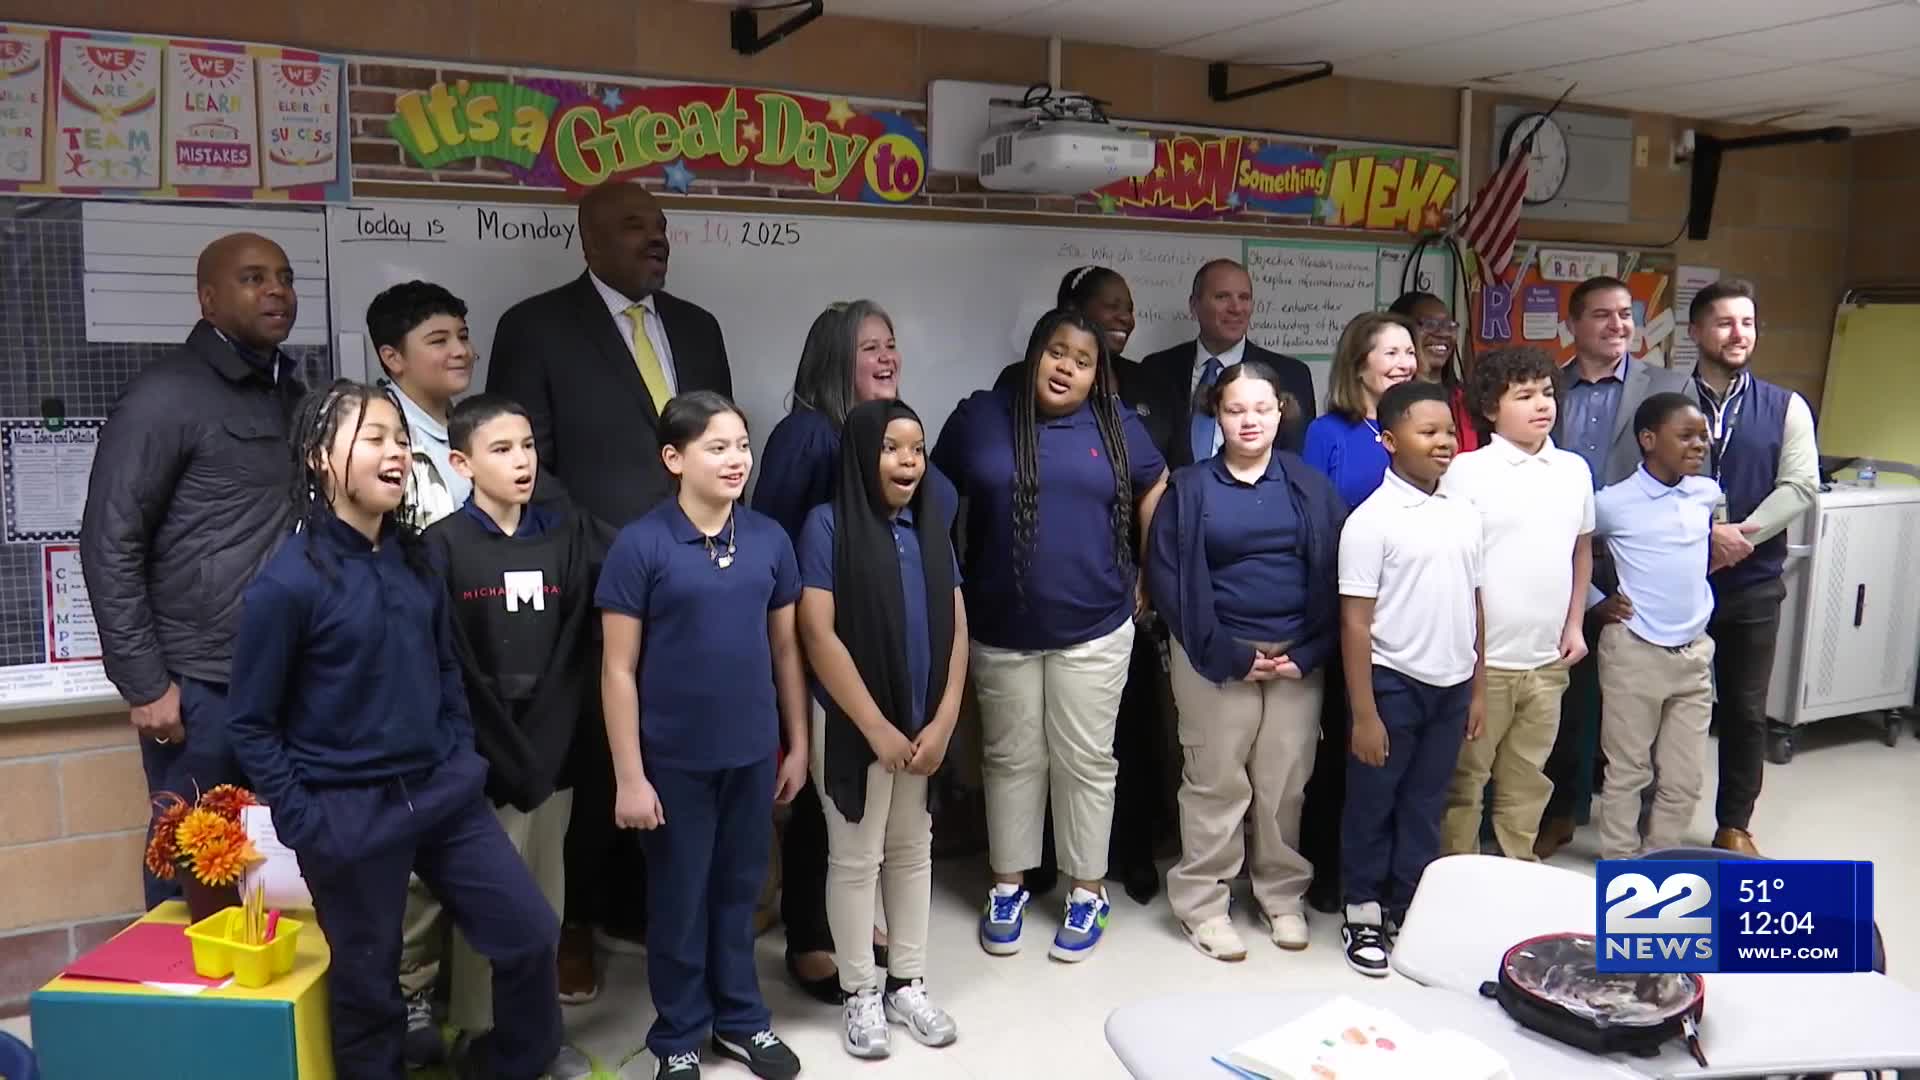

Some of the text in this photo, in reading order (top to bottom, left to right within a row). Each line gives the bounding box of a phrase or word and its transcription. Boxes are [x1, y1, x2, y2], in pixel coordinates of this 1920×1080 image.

[95, 49, 127, 66] WE
[197, 57, 225, 73] WE
[287, 67, 314, 82] WE
[92, 84, 129, 97] ARE
[185, 90, 241, 112] LEARN
[62, 127, 152, 151] TEAM
[179, 147, 248, 163] MISTAKES
[394, 79, 500, 154] It's
[511, 105, 550, 154] a
[555, 87, 748, 186] Great
[753, 92, 869, 194] Day
[873, 142, 921, 193] to
[1240, 158, 1326, 195] Something
[1328, 155, 1459, 233] NEW!
[345, 206, 411, 243] Today
[427, 218, 445, 236] is
[477, 207, 575, 249] Monday
[740, 221, 801, 247] 2025
[1481, 284, 1512, 339] R
[504, 570, 545, 612] M
